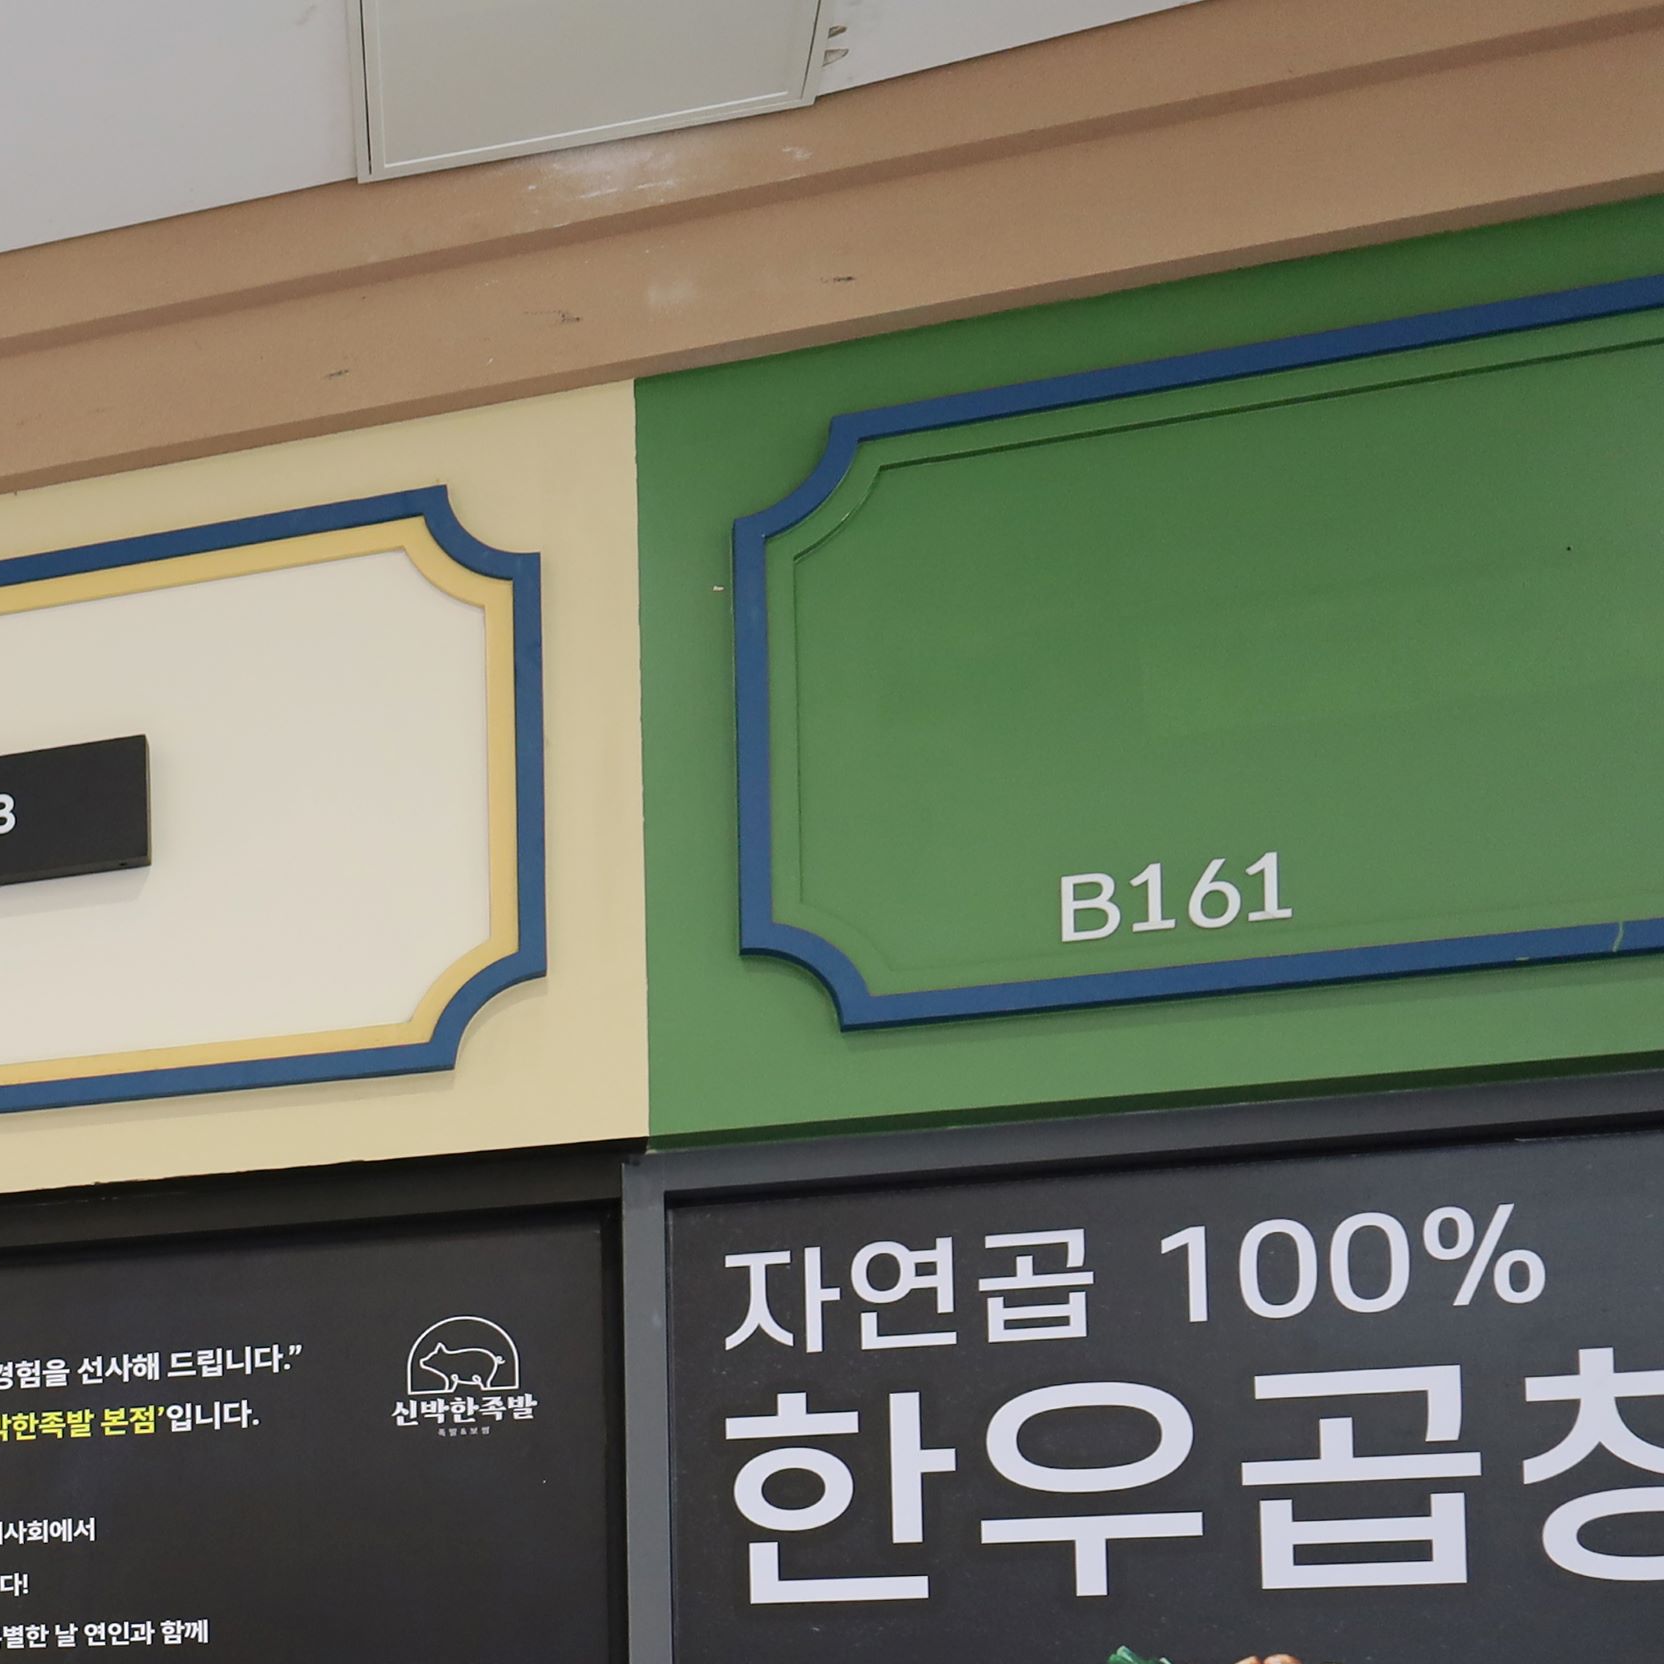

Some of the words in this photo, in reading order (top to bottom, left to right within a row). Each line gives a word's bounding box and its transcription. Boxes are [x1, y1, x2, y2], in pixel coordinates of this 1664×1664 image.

[1059, 851, 1294, 943] B161
[724, 1227, 1095, 1353] 자연곱
[1160, 1202, 1546, 1323] 100%
[76, 1351, 160, 1385] 선사해
[391, 1393, 539, 1426] 신박한족발
[54, 1622, 79, 1648] 날
[83, 1620, 156, 1647] 연인과
[159, 1618, 209, 1645] 함께
